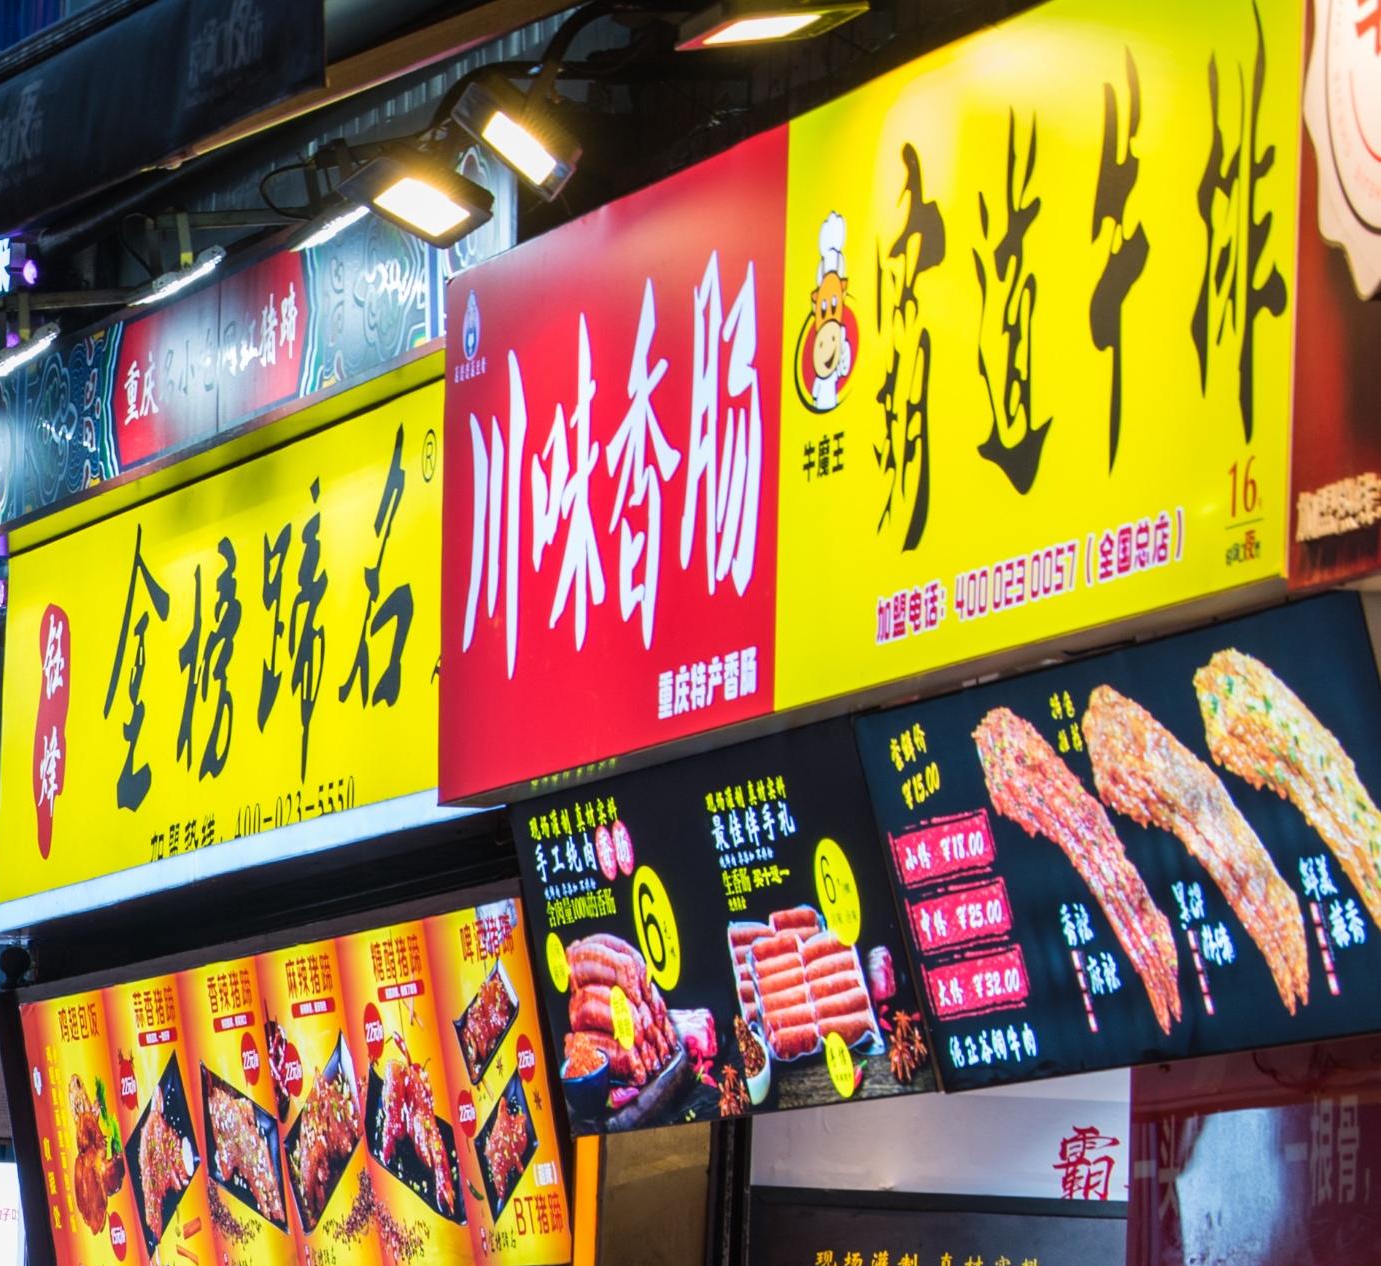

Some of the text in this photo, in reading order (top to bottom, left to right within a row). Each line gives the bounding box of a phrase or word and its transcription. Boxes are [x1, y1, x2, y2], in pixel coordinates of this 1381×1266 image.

[873, 6, 1287, 553] 霸道牛排
[463, 250, 764, 680] 川味香肠
[802, 431, 845, 483] 牛魔王
[954, 569, 989, 619] 400
[992, 558, 1026, 611] 023
[1030, 542, 1076, 601] 0057
[103, 424, 415, 811] 金榜蹄名
[657, 646, 757, 719] 重庆特产香肠
[901, 762, 941, 810] ¥15.00
[529, 796, 618, 841] 现场灌制 真材实料
[711, 801, 796, 851] 最佳伴手礼
[535, 820, 632, 883] 手工纯肉香肠
[820, 855, 837, 905] 6
[460, 914, 515, 965] 啤酒猪蹄
[638, 882, 666, 973] 6
[956, 900, 1003, 931] ¥25.00
[285, 953, 333, 998] 麻辣猪蹄
[370, 934, 423, 983] 糖醋猪蹄
[133, 985, 176, 1028] 蒜香猪蹄
[207, 971, 253, 1014] 香辣猪蹄
[973, 968, 1020, 1000] ¥32.00
[513, 1192, 564, 1237] BT猪蹄
